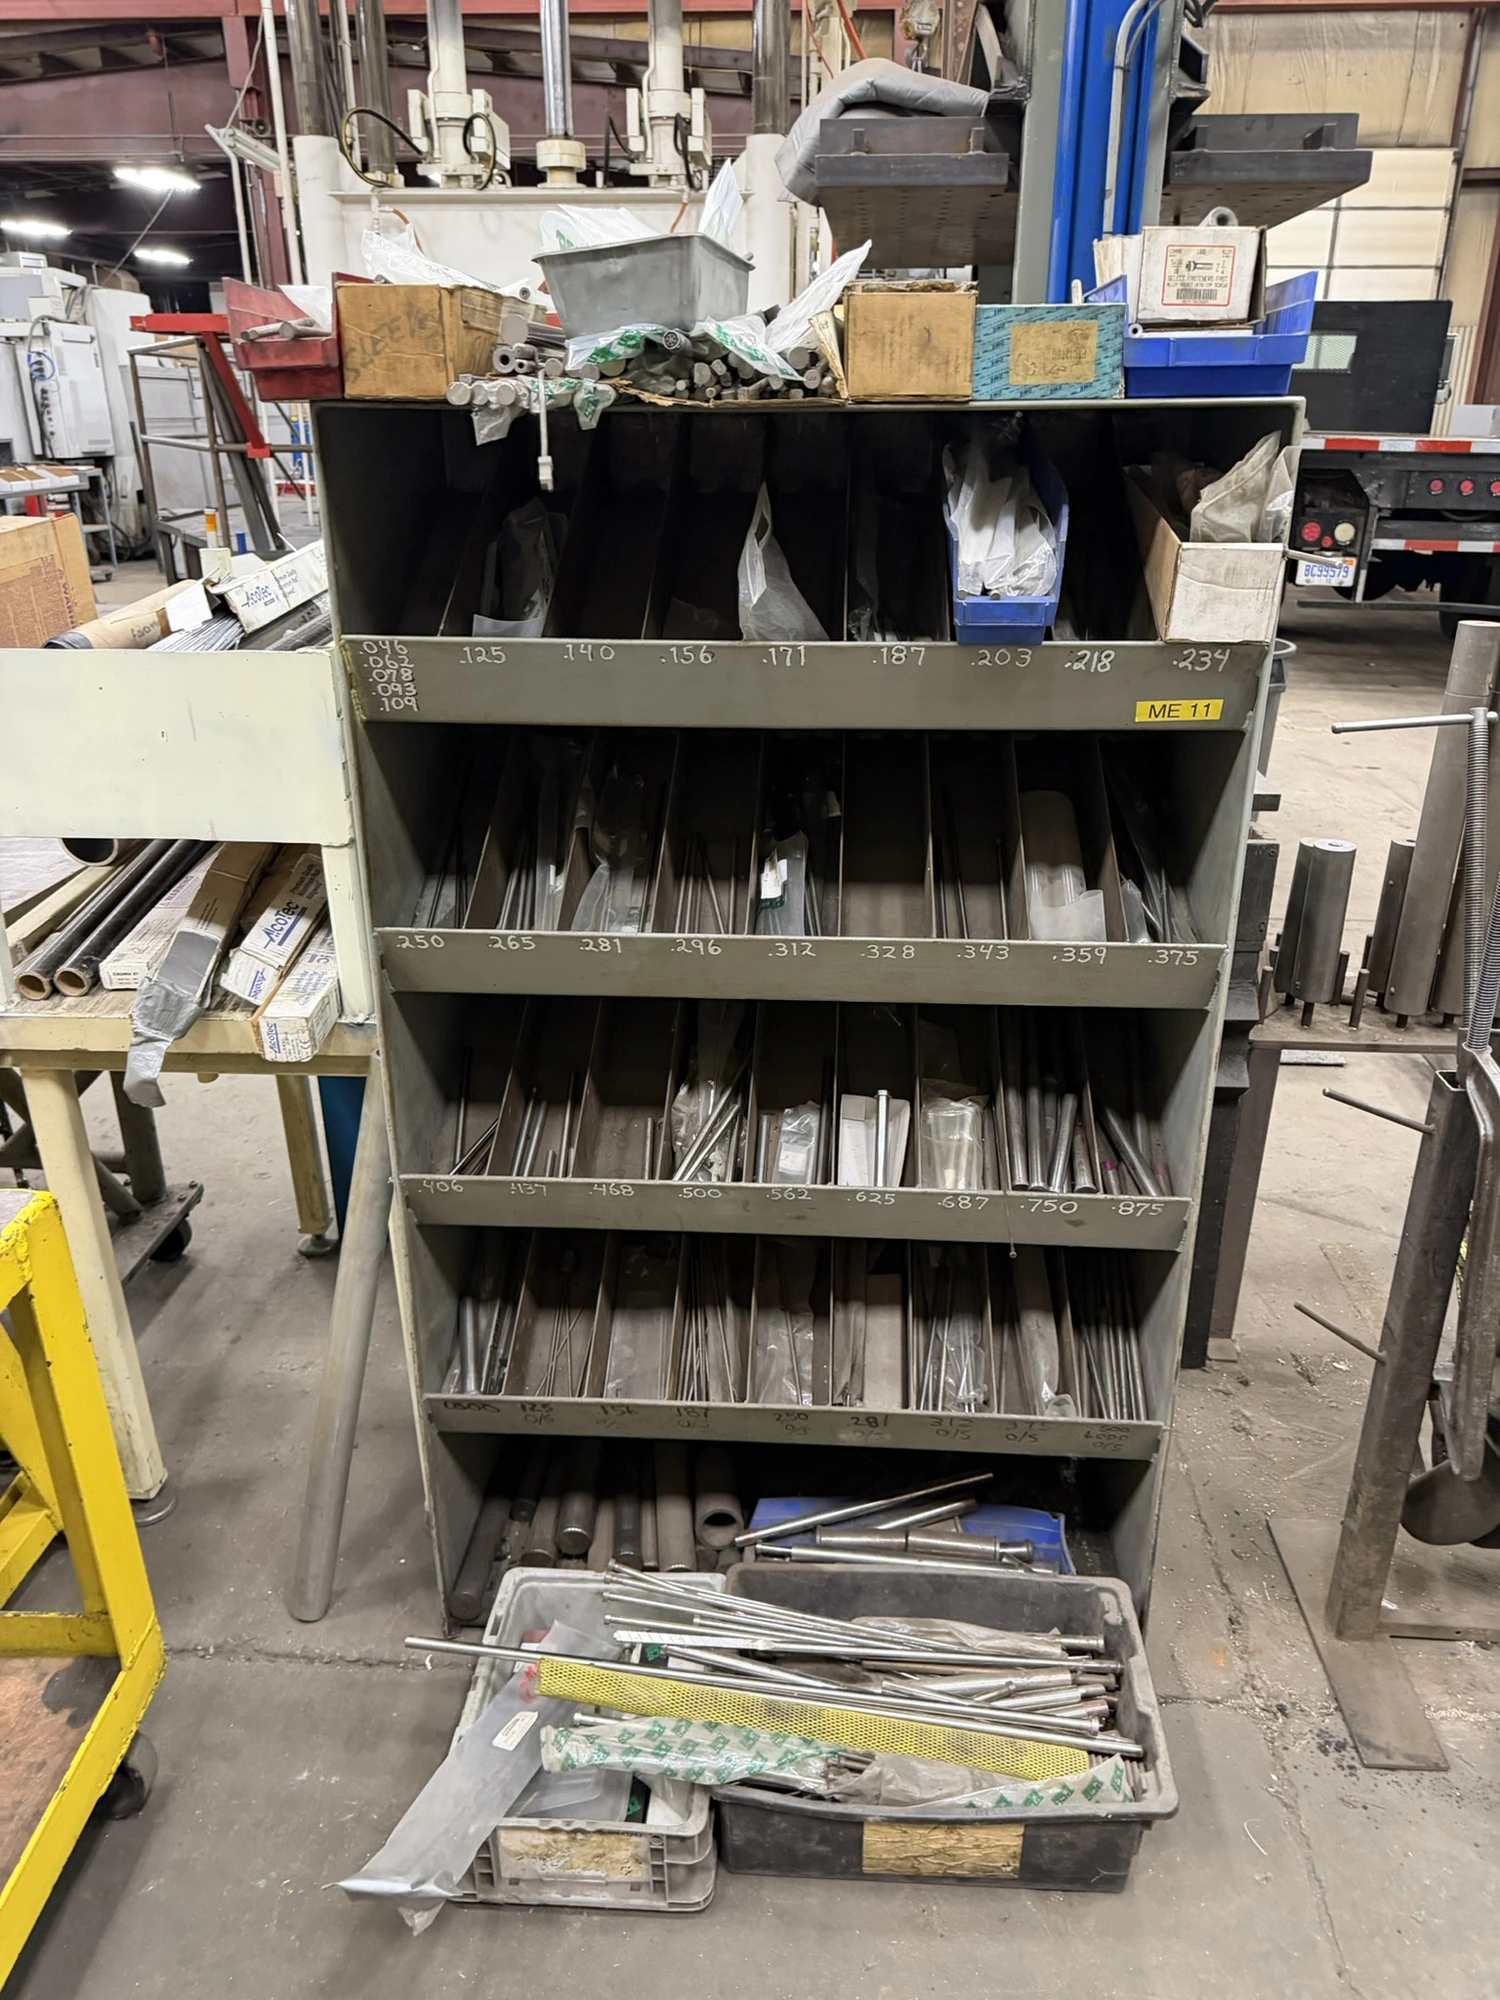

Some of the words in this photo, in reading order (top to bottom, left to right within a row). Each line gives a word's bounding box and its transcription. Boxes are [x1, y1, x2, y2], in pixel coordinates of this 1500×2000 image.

[360, 640, 408, 655] .046
[460, 646, 507, 664] .125
[563, 644, 615, 661] .140
[364, 655, 414, 668] .062
[661, 646, 713, 665] .156
[762, 645, 807, 666] .171
[872, 646, 925, 665] .187
[971, 648, 1032, 668] .203
[1065, 650, 1115, 672] .218
[1173, 649, 1231, 672] .234
[369, 668, 413, 682] .078
[372, 682, 417, 696] .093
[380, 697, 418, 712] .109
[1148, 703, 1181, 719] ME
[1190, 703, 1211, 718] 11
[396, 936, 445, 949] .250
[488, 936, 536, 950] .265
[579, 938, 622, 953] .281
[670, 939, 722, 955] .296
[768, 943, 816, 957] .312
[860, 945, 915, 959] .328
[957, 945, 1010, 959] .343
[1052, 948, 1107, 964] .359
[1147, 950, 1200, 966] .375
[418, 1180, 463, 1194] .406
[589, 1183, 635, 1196] .468
[678, 1187, 721, 1199] .500
[766, 1188, 812, 1200] .562
[846, 1191, 896, 1205] .625
[937, 1196, 989, 1210] .687
[1019, 1199, 1078, 1214] .750
[1111, 1201, 1165, 1216] .875
